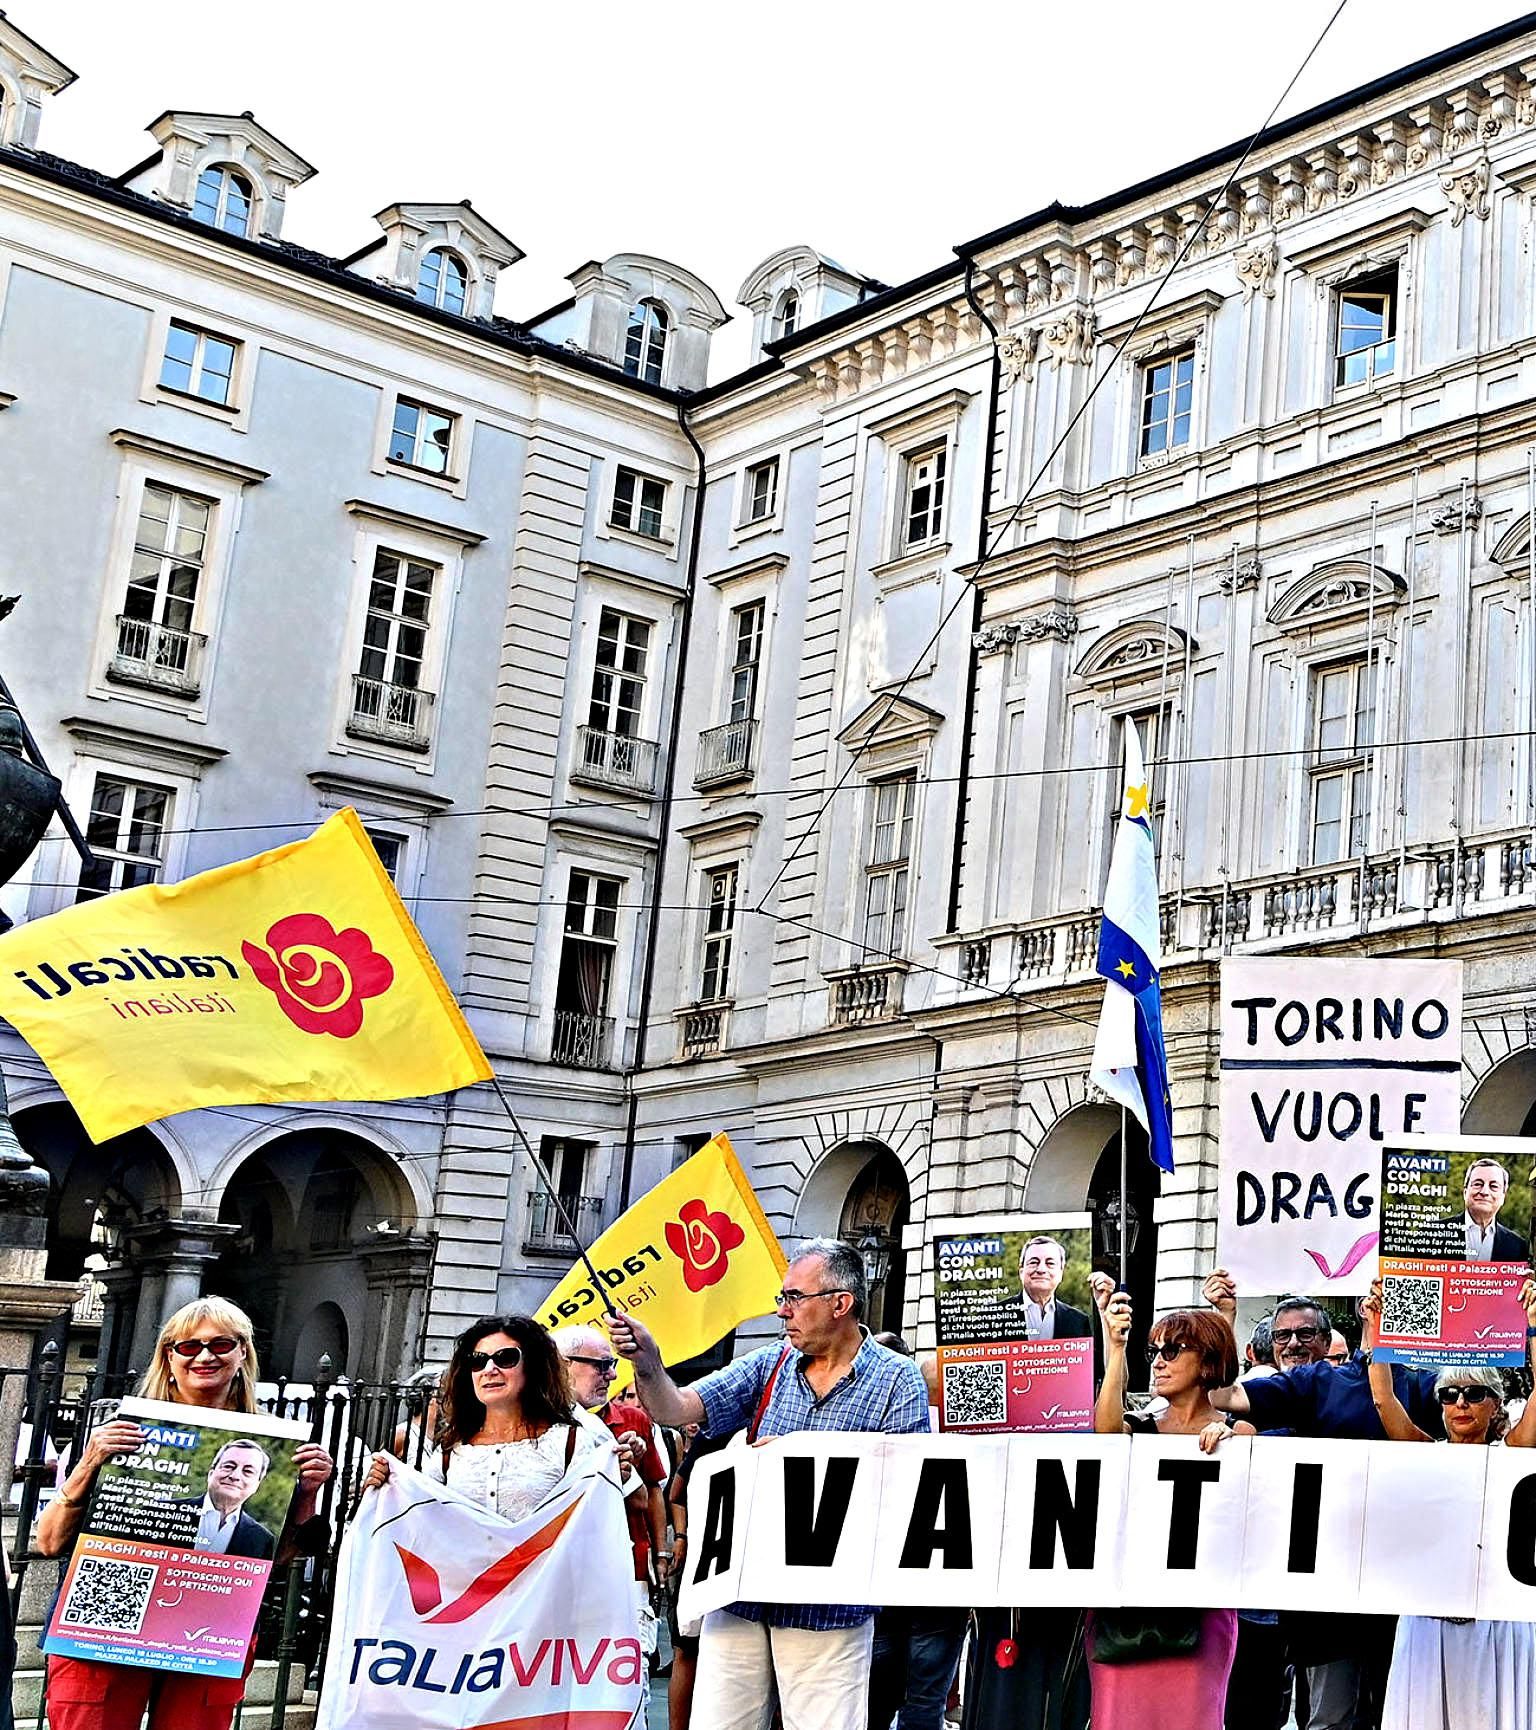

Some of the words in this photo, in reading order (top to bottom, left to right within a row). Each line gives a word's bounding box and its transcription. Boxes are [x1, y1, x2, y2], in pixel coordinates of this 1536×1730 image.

[1232, 996, 1449, 1048] TORINO
[1251, 1089, 1427, 1143] VUOLE
[1387, 1156, 1446, 1171] AVANTI
[1387, 1169, 1421, 1183] CON
[1386, 1182, 1447, 1197] DRAGHI
[1237, 1170, 1373, 1226] DRAG
[1395, 1204, 1421, 1213] piazza
[1422, 1204, 1452, 1214] perché
[1385, 1211, 1409, 1219] Mario
[1410, 1213, 1440, 1222] Draghi
[1413, 1221, 1445, 1229] Palazzo
[1447, 1222, 1466, 1232] Chig
[939, 1241, 1000, 1256] AVANTI
[1416, 1247, 1442, 1255] venga
[939, 1256, 975, 1269] CON
[1383, 1260, 1423, 1272] DRAGHI
[1425, 1263, 1448, 1273] resti
[1450, 1265, 1457, 1273] a
[1459, 1263, 1498, 1274] Palazzo
[940, 1268, 1003, 1283] DRAGHI
[1449, 1279, 1502, 1287] SOTTOSCRIVI
[1503, 1280, 1517, 1288] QUI
[950, 1290, 977, 1299] piazza
[979, 1287, 1009, 1297] perché
[1462, 1288, 1503, 1296] PETIZIONE
[940, 1298, 965, 1306] Mario
[967, 1296, 997, 1306] Draghi
[940, 1307, 961, 1315] resti
[970, 1304, 1004, 1313] Palazzo
[966, 1321, 990, 1329] vuole
[991, 1320, 1004, 1328] far
[976, 1330, 1002, 1339] venga
[943, 1346, 985, 1359] DRAGHI
[987, 1346, 1010, 1356] resti
[1021, 1343, 1061, 1354] Palazzo
[1063, 1341, 1090, 1352] Chigi
[1012, 1357, 1066, 1368] SOTTOSCRIVI
[1068, 1356, 1082, 1365] QUI
[1013, 1368, 1024, 1376] LA
[1025, 1366, 1069, 1376] PETIZIONE
[139, 1425, 196, 1447] VANTI
[135, 1443, 159, 1456] ON
[111, 1454, 189, 1475] DRAGHI
[105, 1474, 115, 1483] In
[116, 1476, 150, 1489] piazza
[153, 1480, 190, 1494] perché
[101, 1483, 134, 1496] Mario
[135, 1486, 172, 1501] Draghi
[99, 1492, 122, 1503] resti
[136, 1497, 177, 1511] Palazzo
[93, 1511, 102, 1519] di
[105, 1513, 120, 1522] chi
[123, 1515, 153, 1526] vuole
[155, 1518, 174, 1529] far
[175, 1521, 198, 1533] male
[692, 1457, 1323, 1585] AVANTI
[133, 1527, 165, 1539] venga
[84, 1540, 137, 1555] DRAGHI
[140, 1547, 168, 1560] resti
[170, 1553, 179, 1562] a
[181, 1553, 230, 1569] Palazzo
[233, 1560, 267, 1575] Chigi
[167, 1568, 232, 1584] SOTTOSCRIVI
[234, 1578, 253, 1587] QUI
[163, 1578, 177, 1588] LA
[179, 1580, 233, 1595] PETIZIONE
